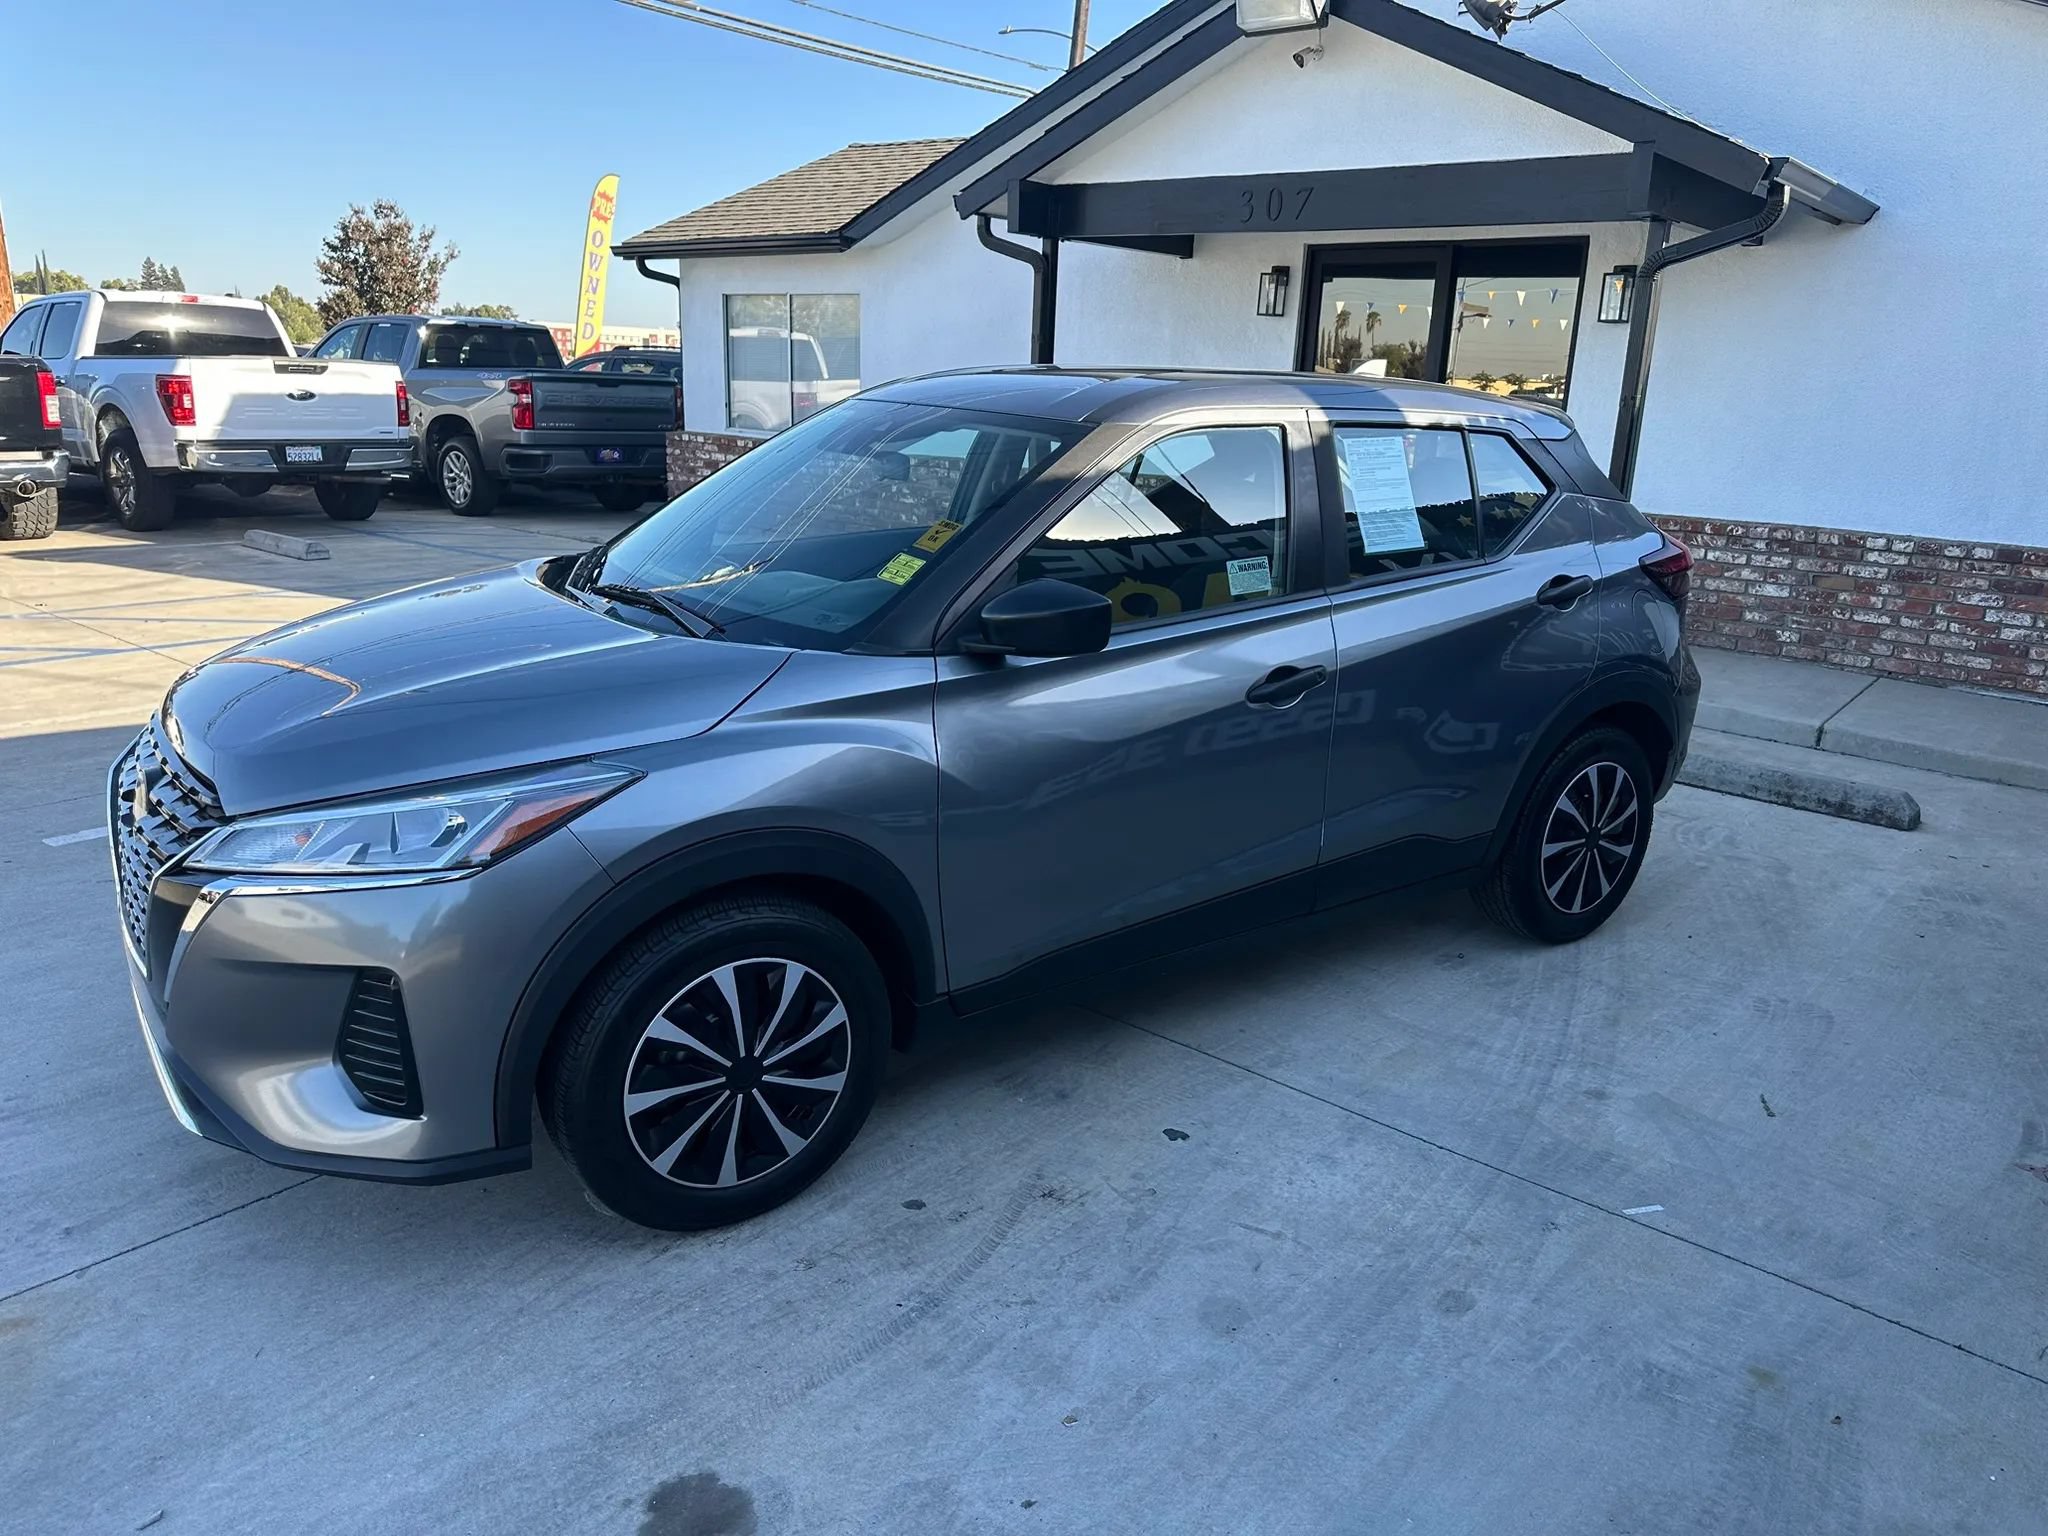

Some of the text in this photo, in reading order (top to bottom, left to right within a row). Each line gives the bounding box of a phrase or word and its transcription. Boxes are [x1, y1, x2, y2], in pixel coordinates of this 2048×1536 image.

[1240, 186, 1314, 224] 307
[581, 230, 604, 341] OWNED
[938, 520, 959, 531] SMOG
[927, 535, 939, 543] OK
